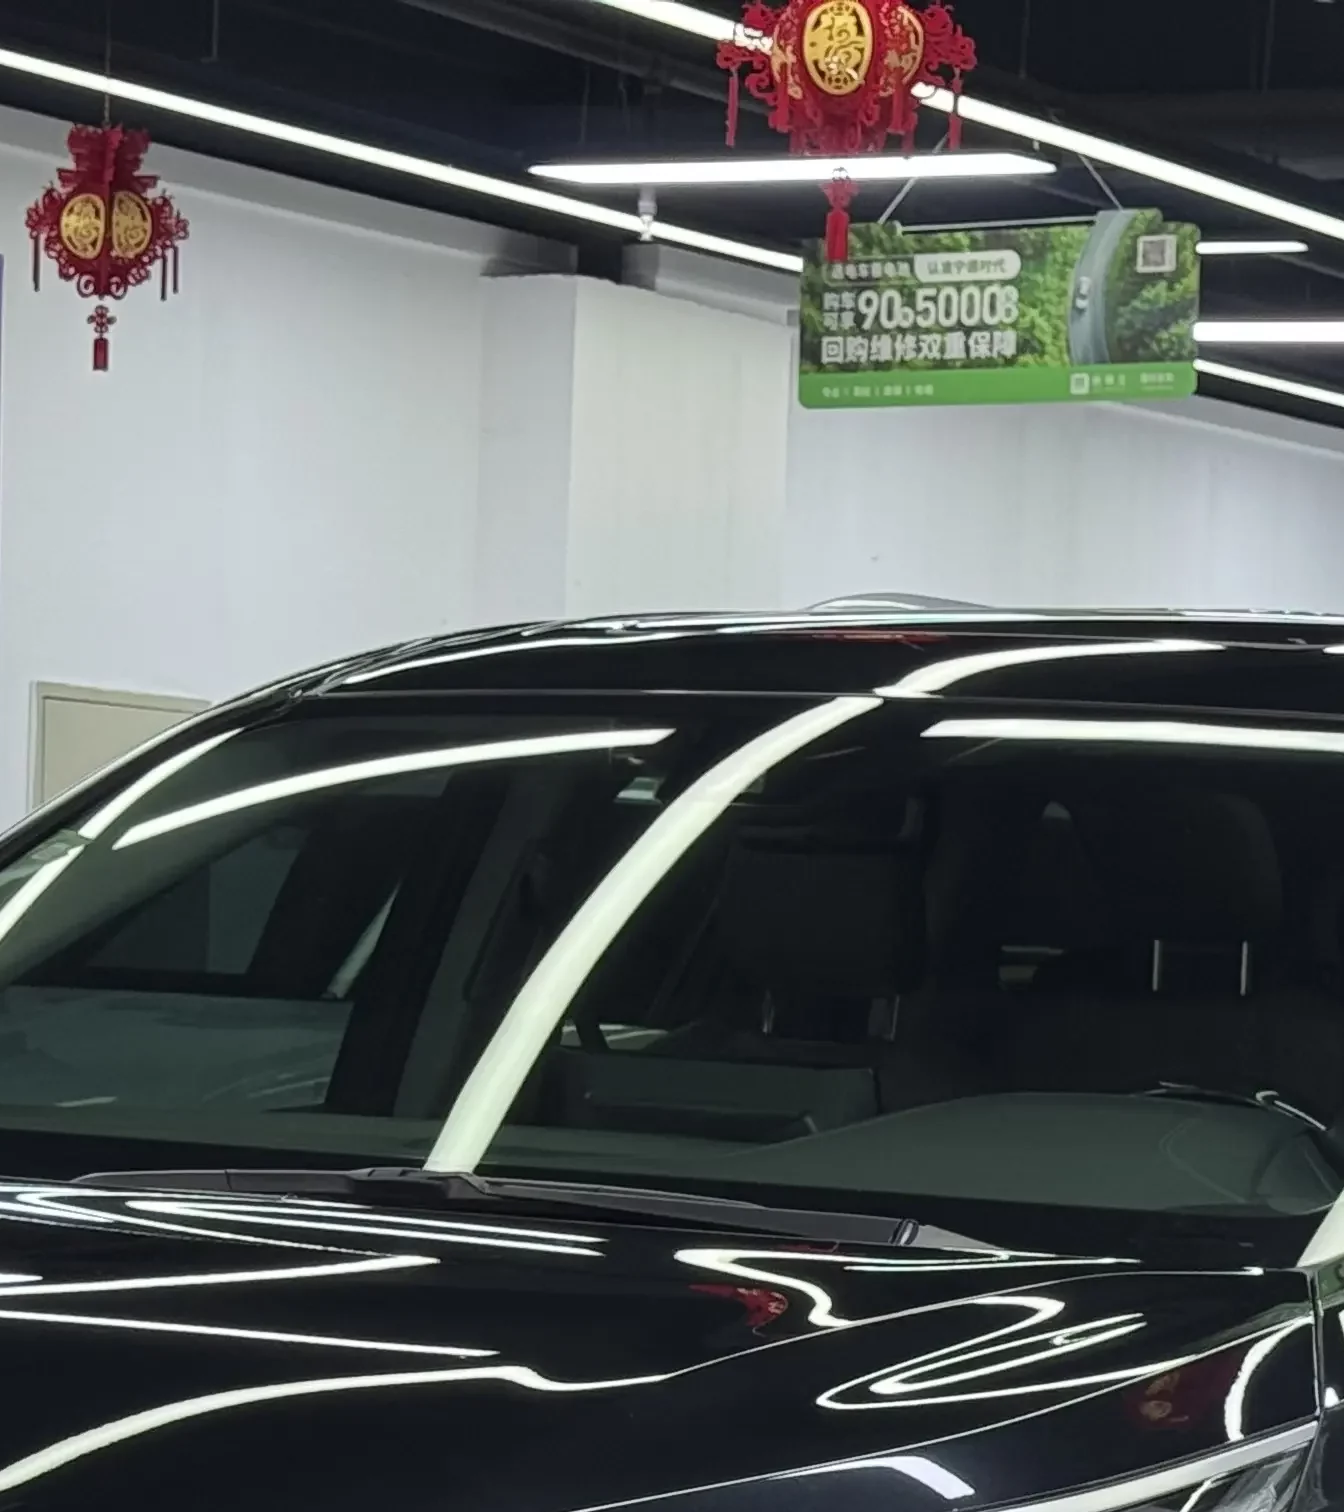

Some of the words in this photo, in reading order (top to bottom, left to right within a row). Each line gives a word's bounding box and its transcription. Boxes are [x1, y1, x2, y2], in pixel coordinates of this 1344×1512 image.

[821, 330, 1018, 364] 回购维修双重保障
